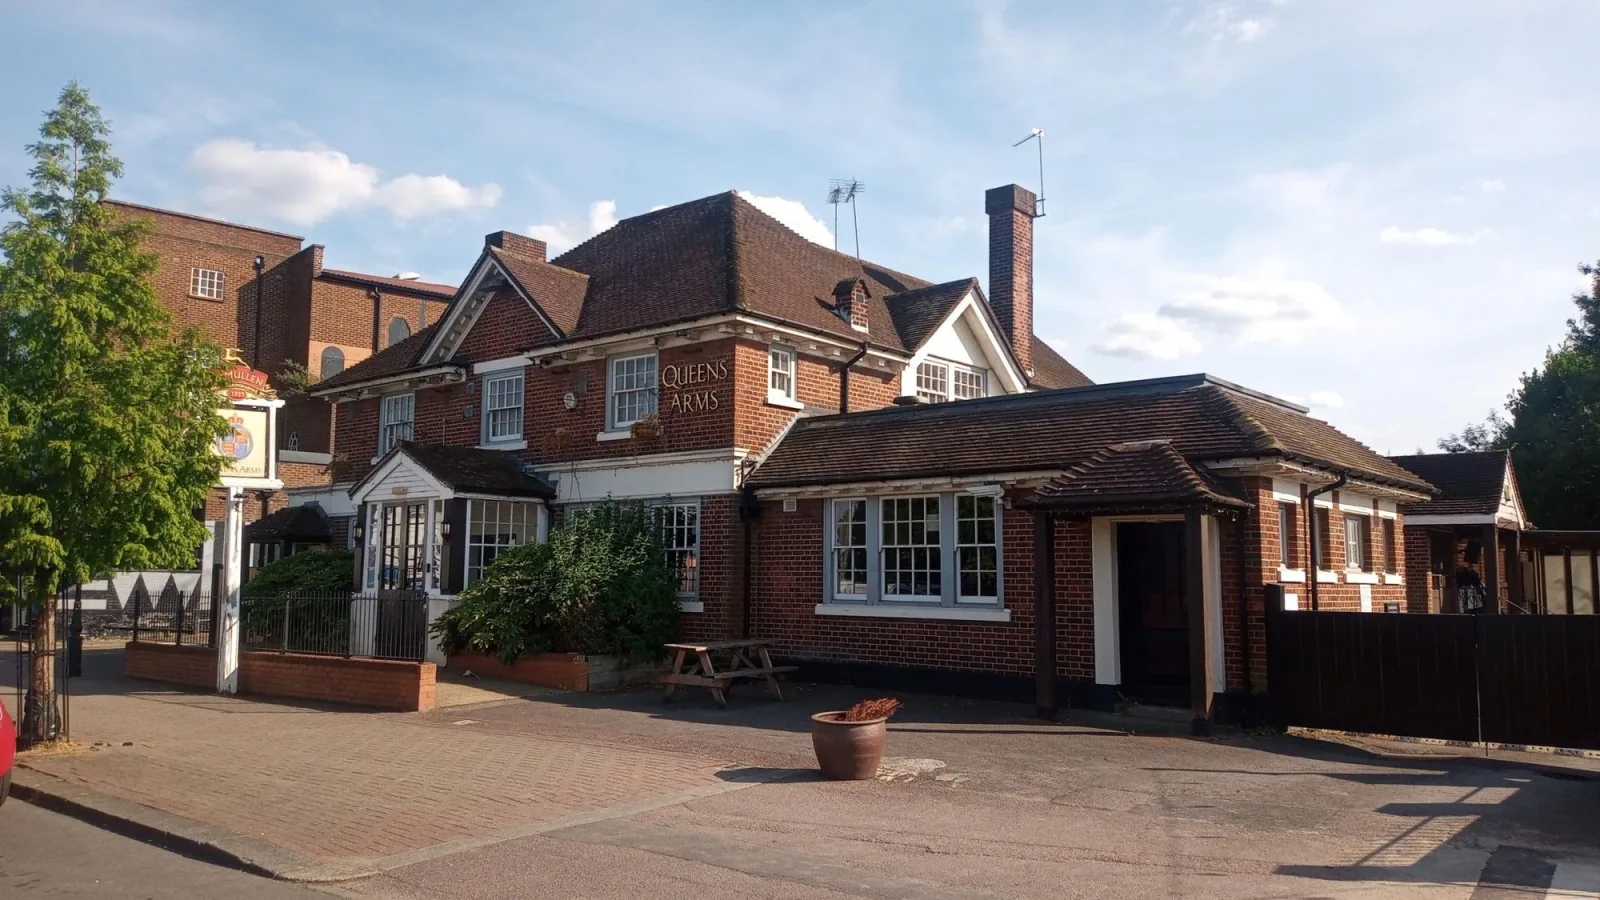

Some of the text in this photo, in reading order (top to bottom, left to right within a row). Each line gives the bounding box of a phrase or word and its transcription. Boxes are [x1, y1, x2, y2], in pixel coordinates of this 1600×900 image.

[221, 369, 264, 387] MULLEN
[662, 359, 728, 389] QUEENS
[670, 390, 719, 413] ARMS
[239, 465, 261, 473] ARMS
